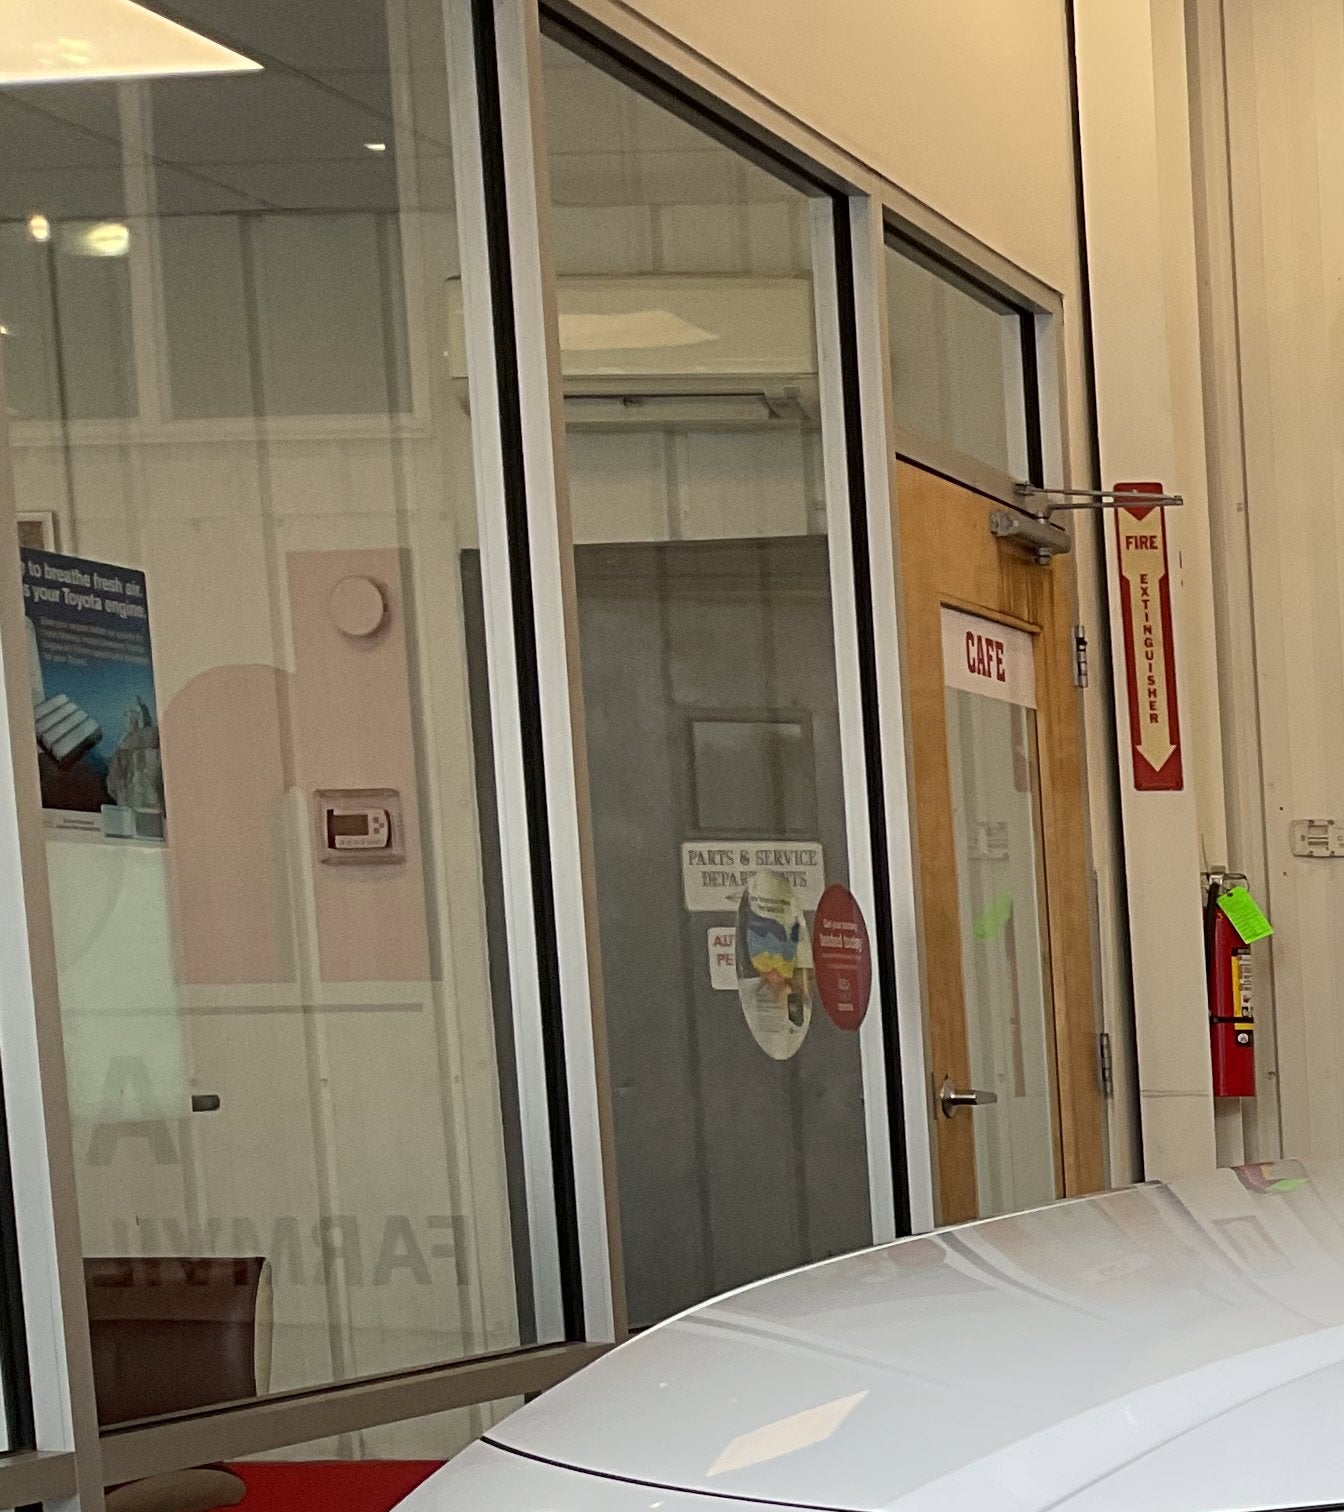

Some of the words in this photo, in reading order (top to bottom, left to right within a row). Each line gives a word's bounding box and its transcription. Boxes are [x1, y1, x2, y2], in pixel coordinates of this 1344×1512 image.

[1125, 535, 1159, 550] FIRE
[28, 560, 42, 578] to
[44, 562, 91, 588] breathe
[93, 573, 123, 594] fresh
[31, 584, 60, 602] your
[62, 587, 103, 611] Toyota
[965, 630, 1006, 683] CAFE
[1139, 573, 1160, 724] EXTINGUISHER
[688, 849, 735, 866] PARTS
[739, 849, 750, 866] &
[755, 849, 818, 866] SERVICE
